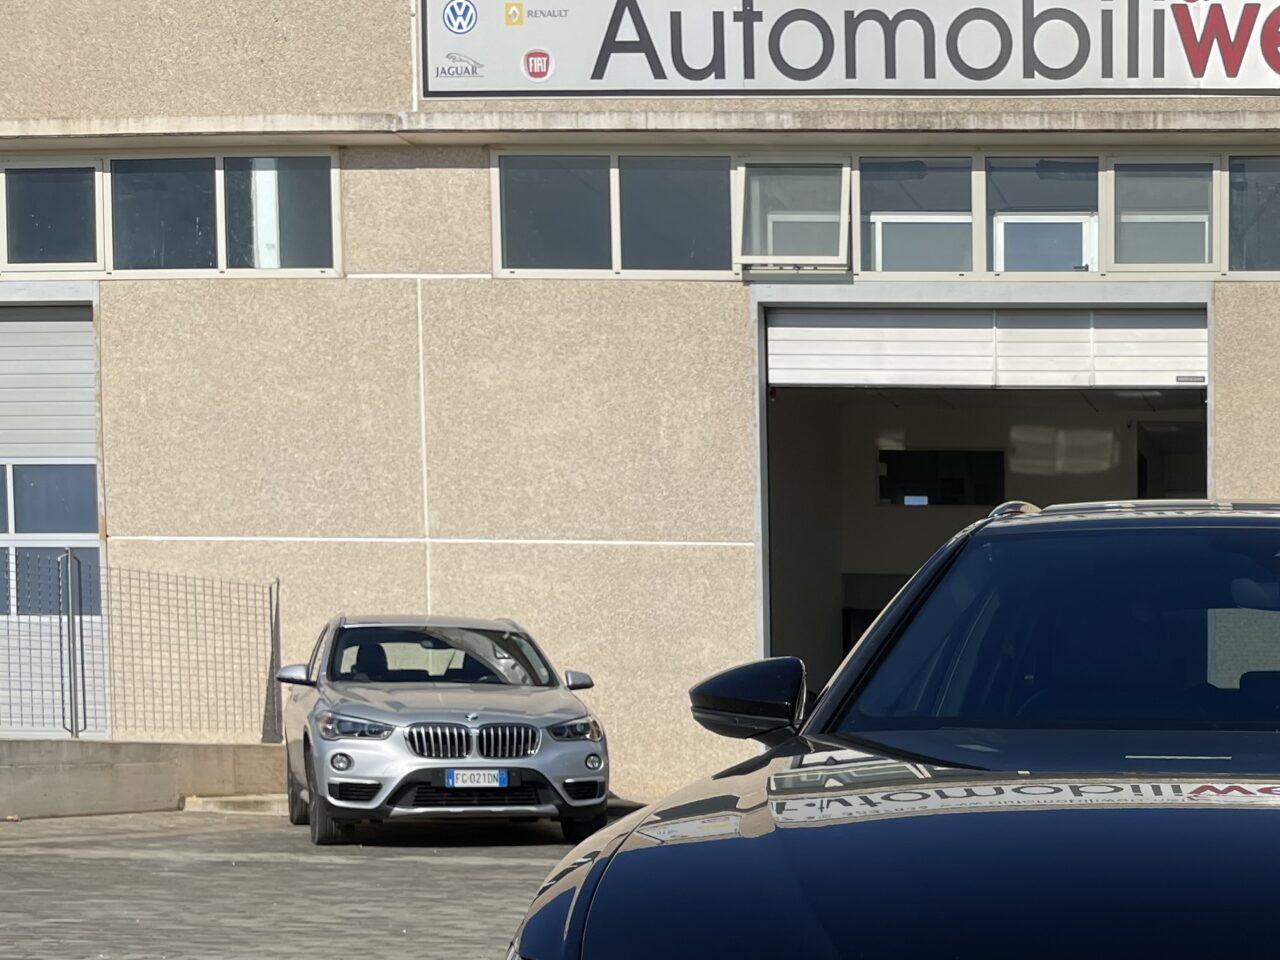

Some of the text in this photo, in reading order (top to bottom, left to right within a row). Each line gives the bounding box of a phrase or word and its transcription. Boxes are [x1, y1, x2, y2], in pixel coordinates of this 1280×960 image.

[527, 9, 568, 18] RENAULT
[529, 57, 548, 73] FIAT
[436, 66, 478, 78] JAGUAR
